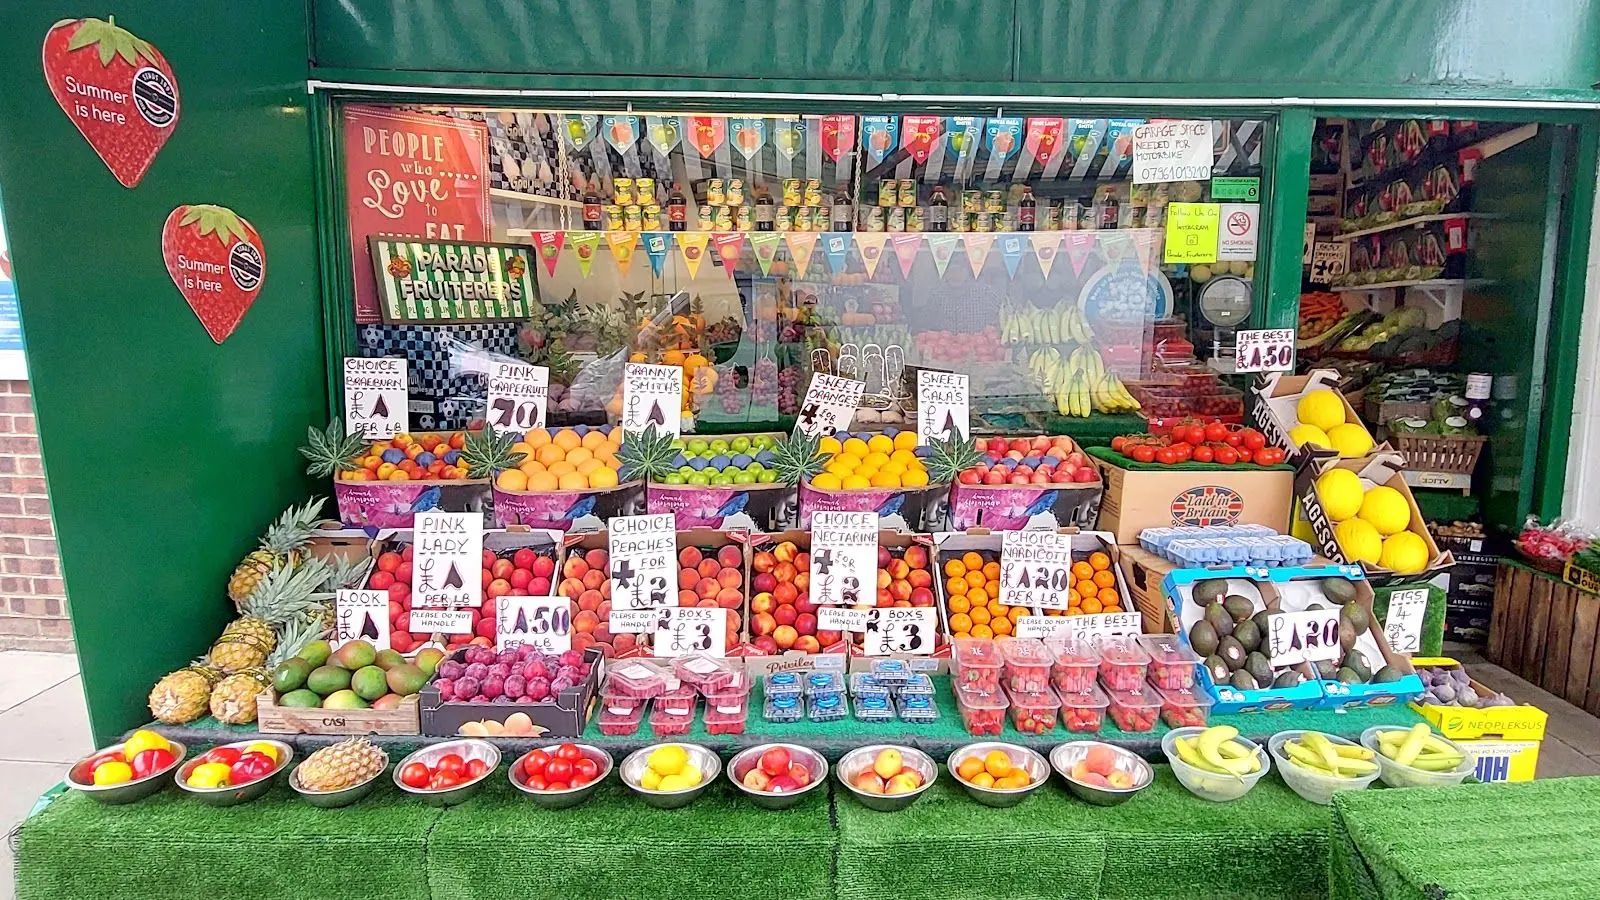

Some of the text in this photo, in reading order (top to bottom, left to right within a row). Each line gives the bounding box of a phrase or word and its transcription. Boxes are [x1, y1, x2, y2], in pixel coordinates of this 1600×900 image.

[65, 75, 129, 105] Summer
[75, 100, 89, 118] is
[92, 104, 126, 125] here
[1135, 124, 1206, 139] GARAGE SPACE
[363, 126, 445, 163] PEOPLE
[1136, 139, 1191, 150] NEEDED FOR
[1136, 150, 1184, 161] MOTORBIKE
[362, 169, 449, 219] Love
[426, 202, 438, 217] to
[1170, 205, 1191, 217] Follow
[1195, 208, 1205, 217] Us
[178, 254, 226, 275] Summer
[419, 251, 501, 274] PARADE
[184, 274, 194, 289] is
[196, 275, 222, 292] here
[401, 279, 522, 301] FRUITERERS
[1240, 330, 1293, 341] THE BEST
[346, 358, 398, 371] CHOICE
[499, 364, 535, 379] PINK
[626, 363, 678, 379] GRANNY
[345, 376, 402, 388] BRAEBURN
[817, 374, 865, 391] SWEET
[921, 372, 966, 386] SWEET
[489, 378, 549, 395] GRAPEFRUIT
[808, 388, 859, 406] ORANGES
[800, 402, 837, 425] 4 FOR
[354, 421, 402, 432] PER LB
[1187, 495, 1229, 506] Laid in
[813, 512, 871, 526] CHOICE
[1185, 507, 1228, 518] Britain
[422, 517, 465, 530] PINK
[612, 516, 674, 533] CHOICE
[812, 530, 877, 543] NECTARINE
[1007, 531, 1066, 545] CHOICE
[422, 538, 469, 552] LADY
[612, 537, 674, 554] PEACHES
[813, 548, 856, 575] 4 FOR
[611, 555, 666, 591] 4 FOR
[630, 573, 670, 608] £2
[817, 574, 861, 603] £2
[339, 591, 381, 604] LOOK
[424, 592, 471, 604] PER LB
[1007, 590, 1060, 603] PER LB
[1391, 590, 1424, 602] FIGS
[1452, 599, 1492, 607] AUBERGIN
[411, 611, 439, 619] PLEASE
[611, 612, 637, 620] PLEASE
[657, 608, 672, 630] 2
[678, 609, 712, 619] BOX'S
[819, 609, 845, 617] PLEASE
[1396, 606, 1411, 620] 4
[620, 620, 652, 628] HANDLE
[866, 608, 924, 633] 2 BOX'S
[1075, 614, 1140, 628] THE BEST
[1386, 622, 1406, 632] FOR
[504, 637, 552, 648] PER LB
[671, 622, 712, 651] £3
[880, 622, 922, 652] £3
[322, 717, 347, 727] CASI
[1467, 721, 1542, 730] NEOPLEKSUS
